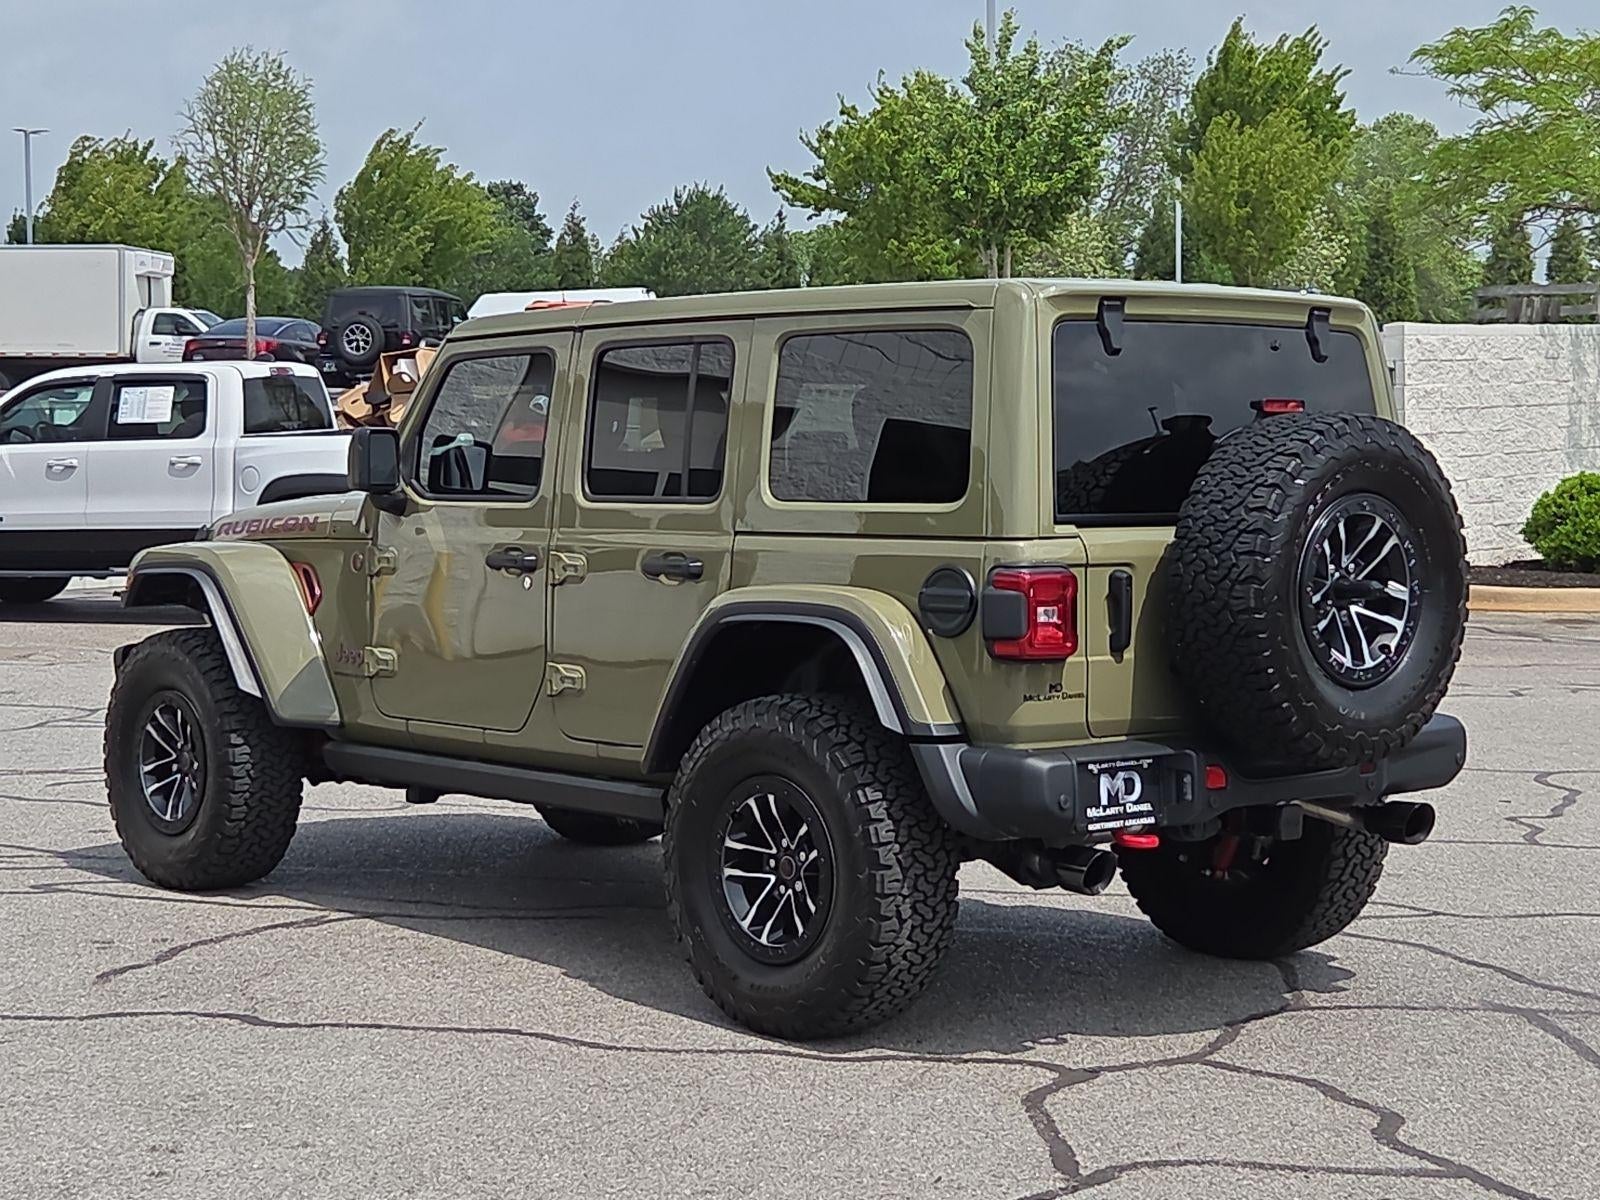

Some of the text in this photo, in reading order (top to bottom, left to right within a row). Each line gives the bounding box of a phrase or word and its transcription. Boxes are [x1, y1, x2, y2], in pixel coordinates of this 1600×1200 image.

[216, 516, 320, 537] RUBICON
[336, 643, 365, 668] Jeep
[1100, 770, 1142, 805] MD
